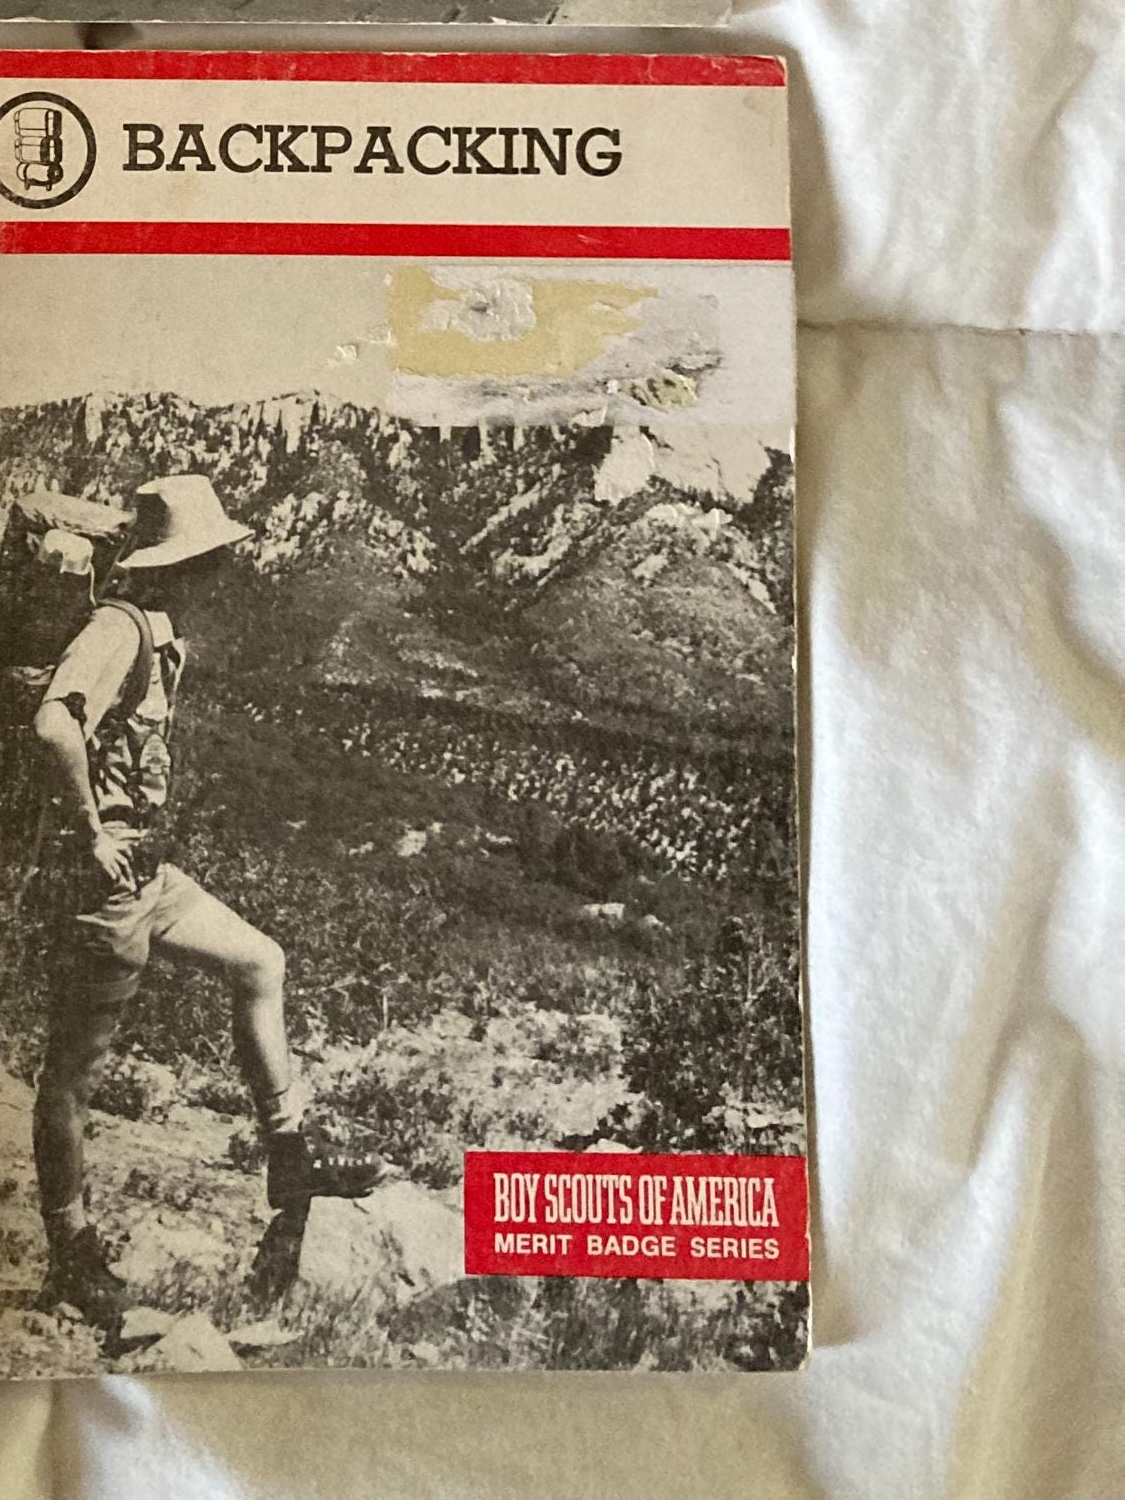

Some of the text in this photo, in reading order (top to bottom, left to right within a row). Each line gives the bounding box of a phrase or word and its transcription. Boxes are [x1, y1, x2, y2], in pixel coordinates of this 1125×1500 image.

[122, 122, 623, 178] BACKPACKING
[494, 1172, 780, 1228] BOY SCOUTS OF AMERICA
[494, 1233, 780, 1260] MERIT BADGE SERIES
